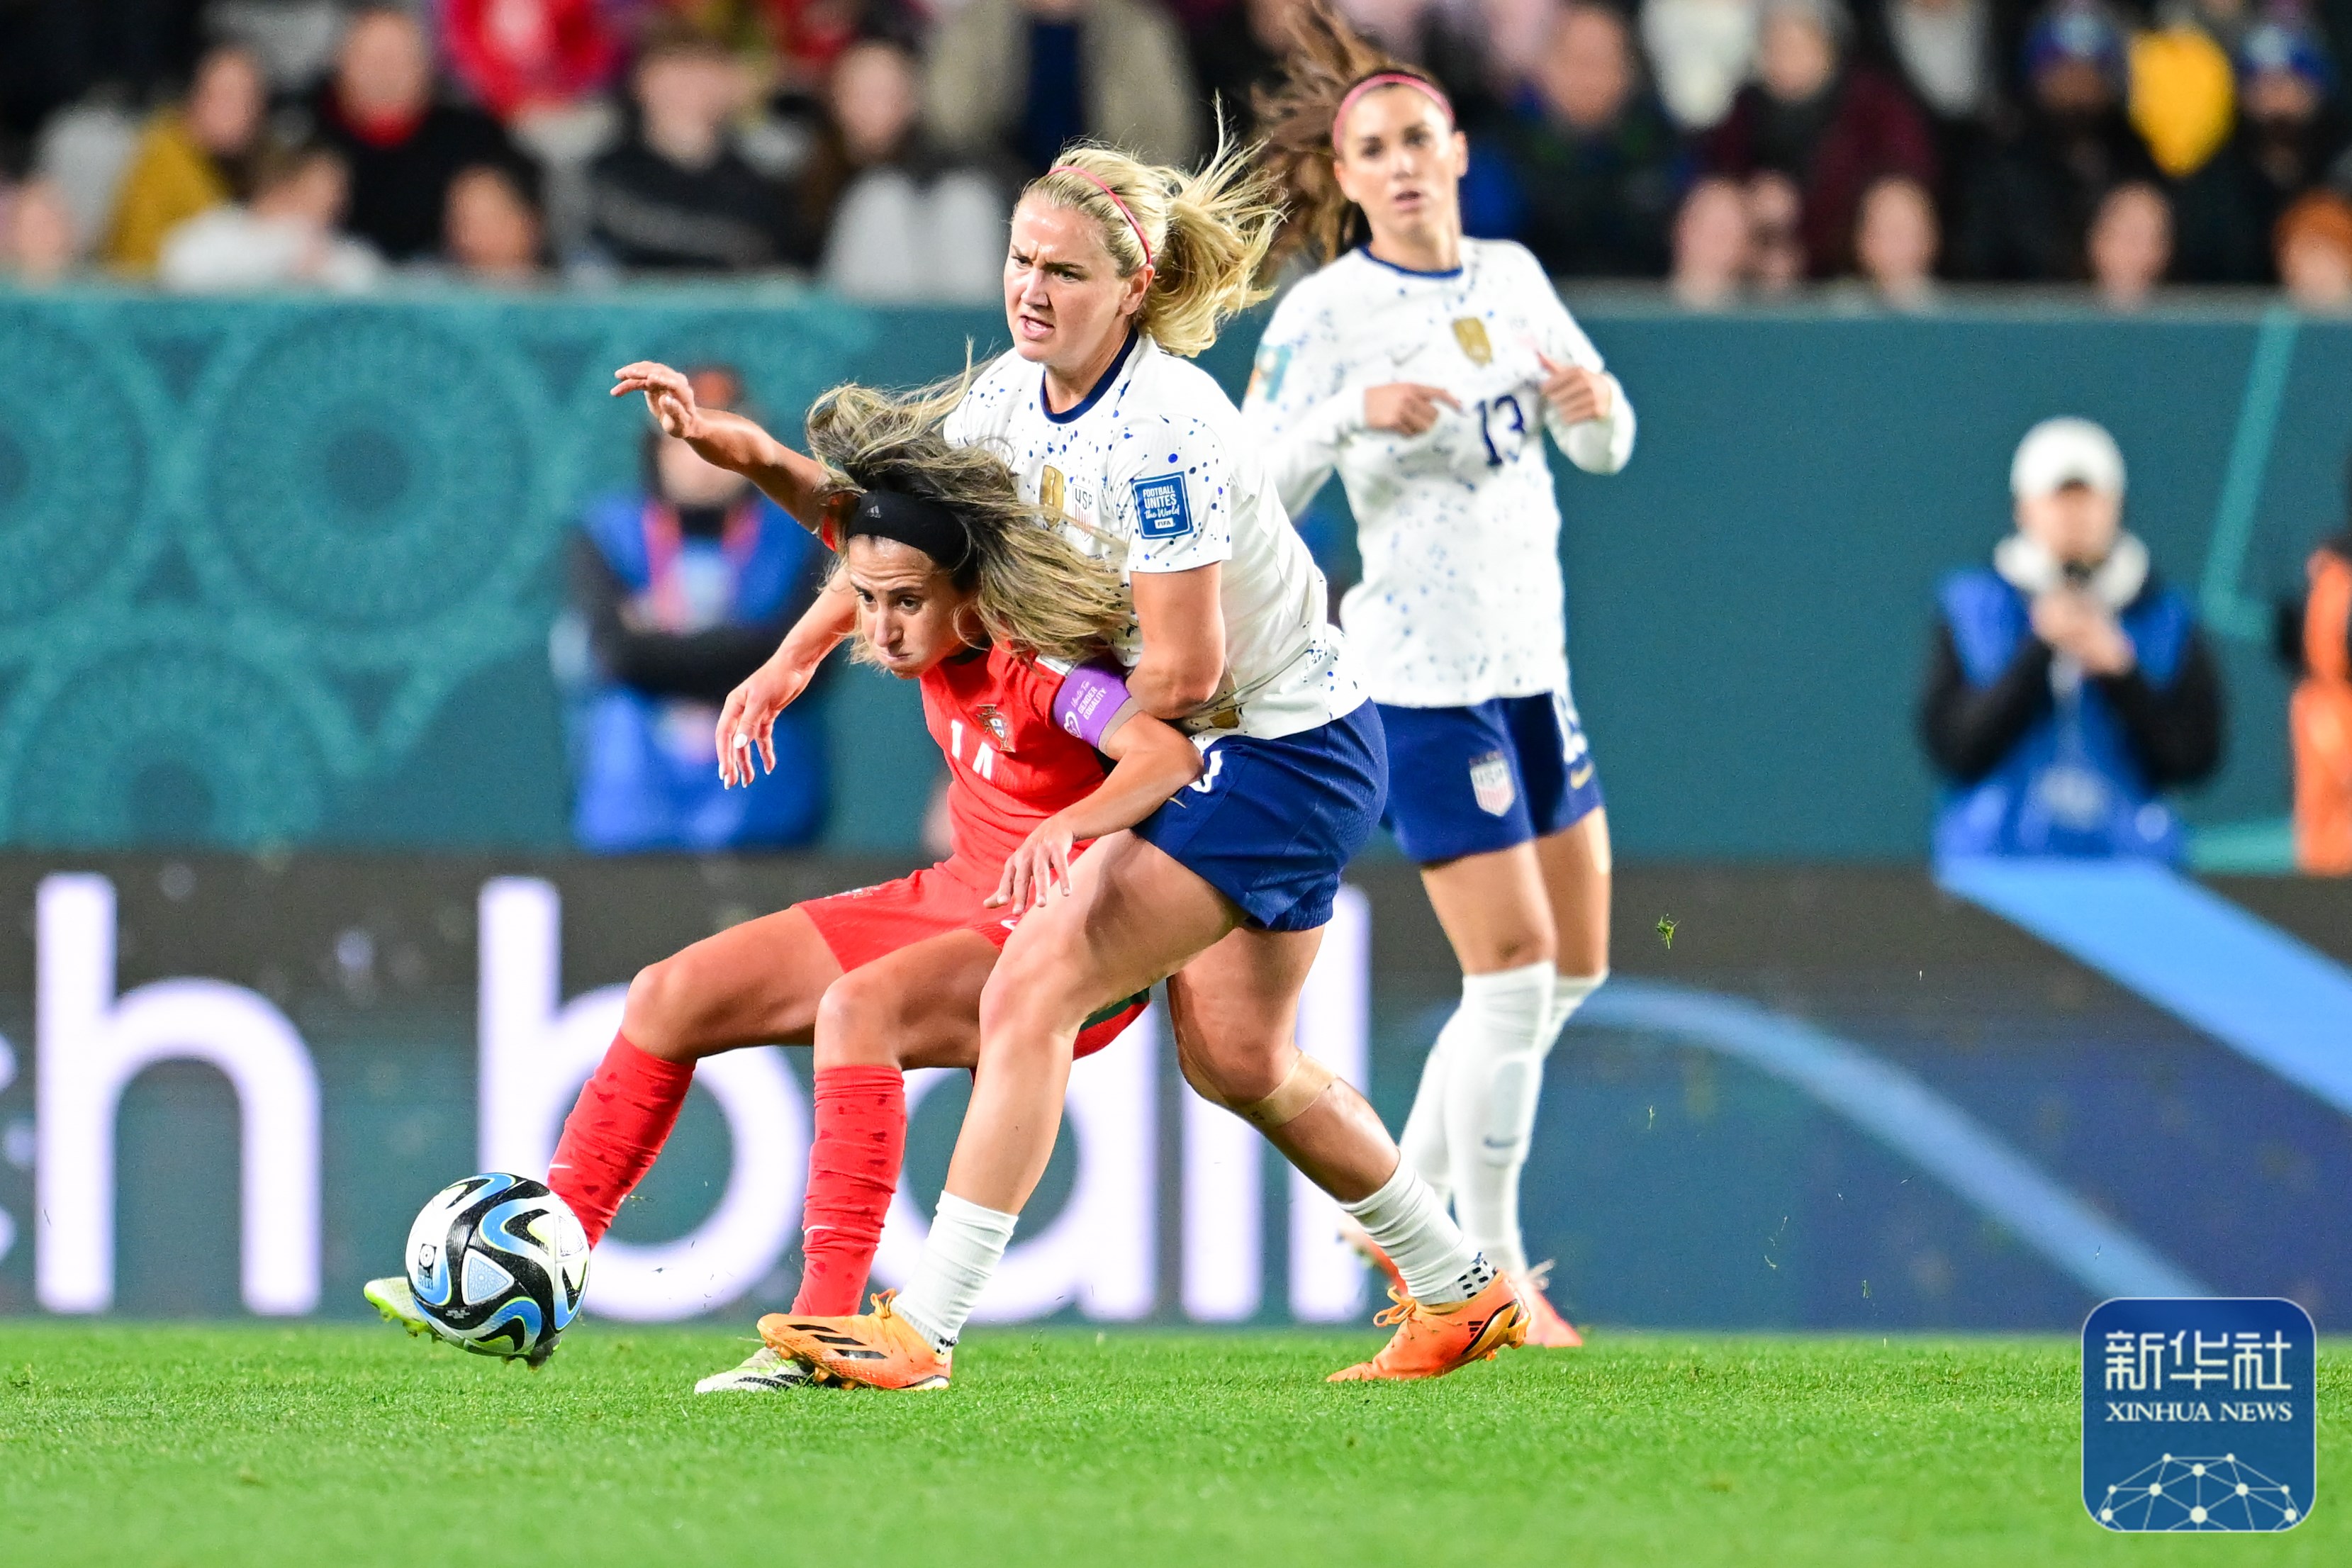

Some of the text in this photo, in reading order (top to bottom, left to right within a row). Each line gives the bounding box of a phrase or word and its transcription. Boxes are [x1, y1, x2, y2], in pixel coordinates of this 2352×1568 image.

[1476, 393, 1526, 467] 13
[1143, 485, 1175, 497] FOOTBALL
[1144, 493, 1177, 509] UNITES
[1077, 686, 1098, 715] GENDER
[1083, 688, 1107, 720] EQUALITY
[0, 873, 322, 1316] h
